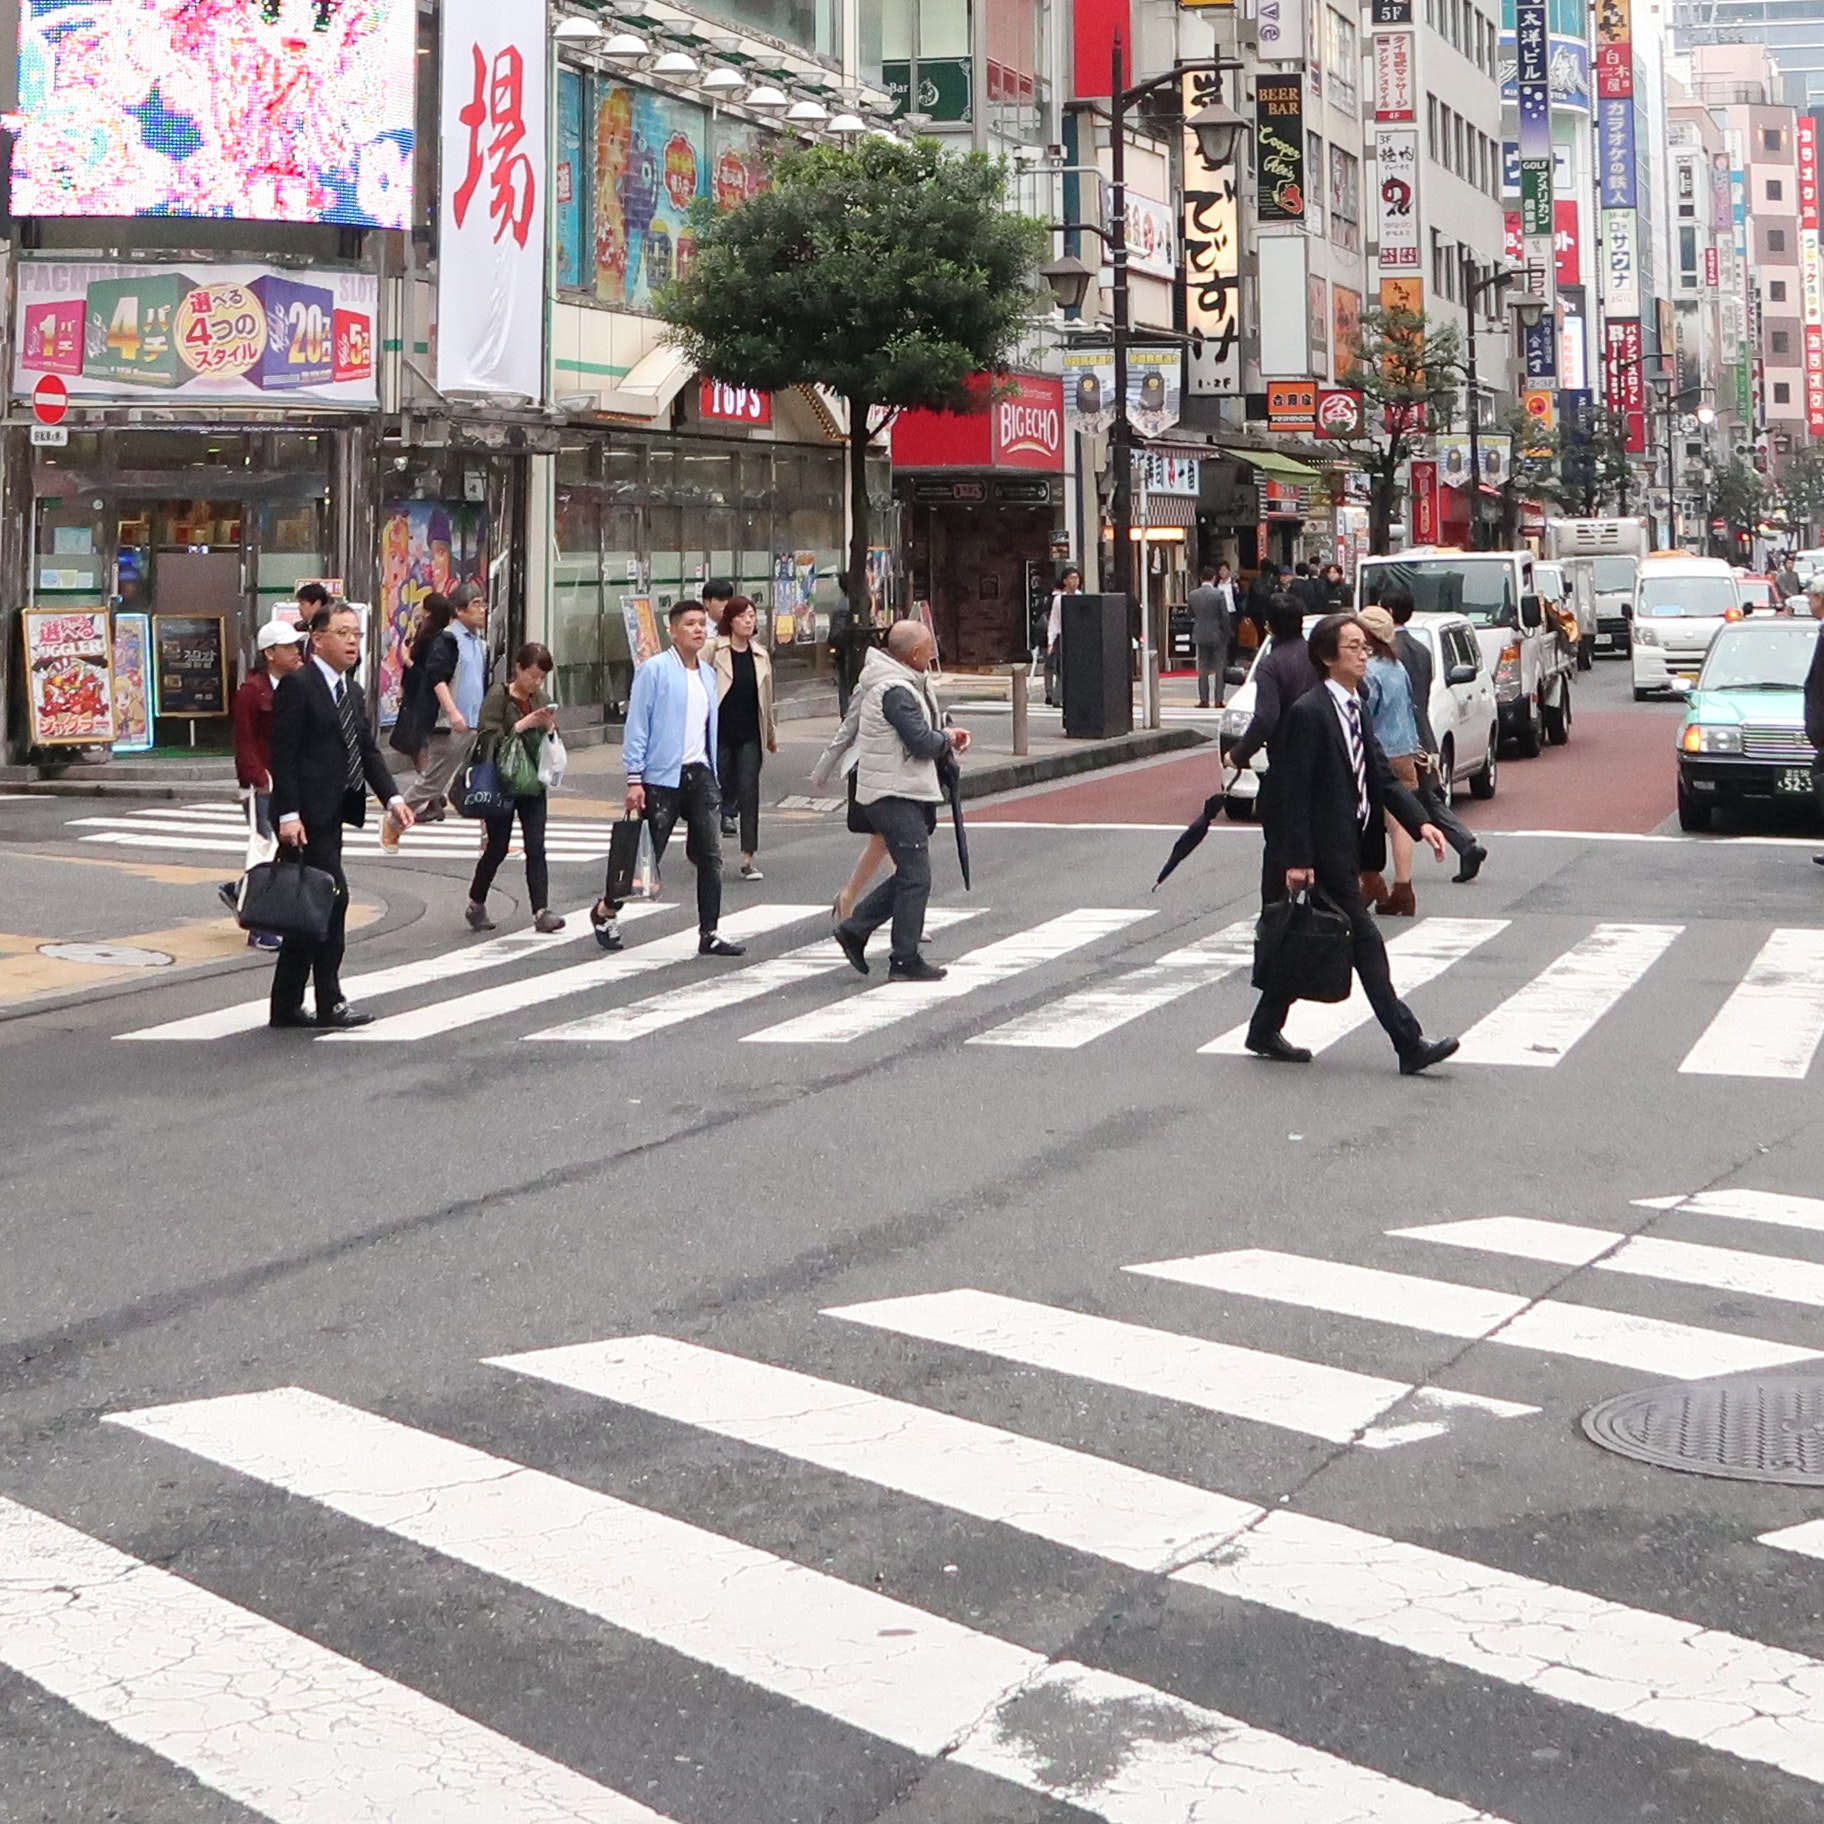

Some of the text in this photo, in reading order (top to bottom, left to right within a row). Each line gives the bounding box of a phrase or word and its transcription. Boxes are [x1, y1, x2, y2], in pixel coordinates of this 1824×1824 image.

[1381, 6, 1403, 21] 5F
[1258, 87, 1299, 101] BEER
[1268, 102, 1299, 115] BAR
[1522, 161, 1548, 170] GOLF
[1610, 233, 1630, 288] サウナ
[190, 288, 243, 314] 選べる
[185, 313, 256, 347] 4つの
[194, 342, 258, 369] スタイル
[999, 402, 1059, 452] BIG ECHO
